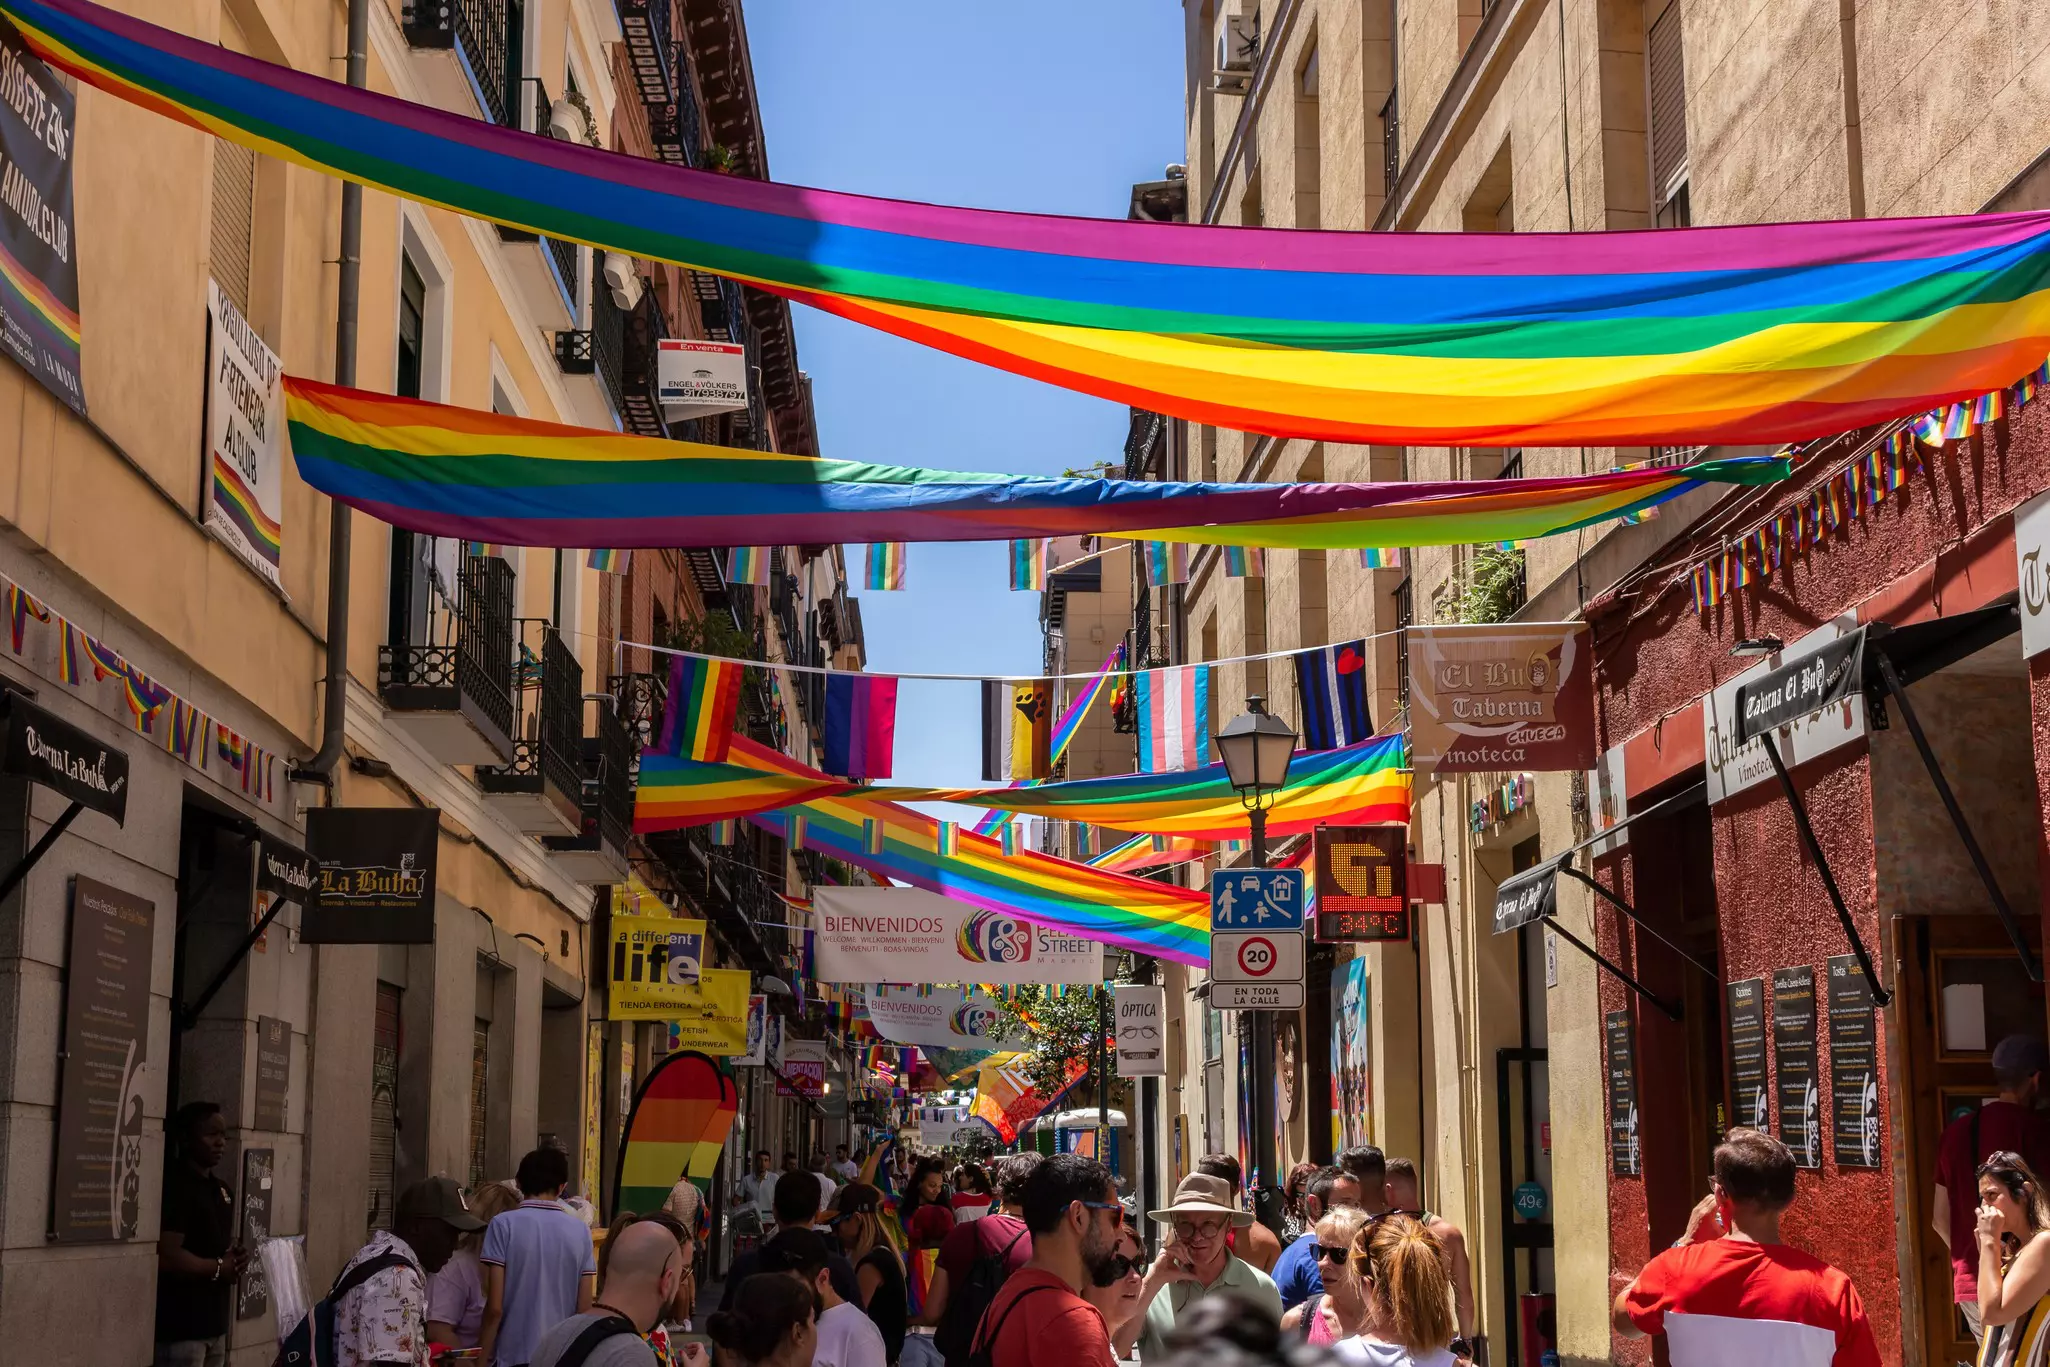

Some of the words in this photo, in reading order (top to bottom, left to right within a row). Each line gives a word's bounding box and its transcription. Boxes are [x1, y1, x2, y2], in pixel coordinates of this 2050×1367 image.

[683, 388, 744, 399] 917938797
[237, 429, 257, 487] CLUB
[1442, 662, 1473, 689] El
[1451, 696, 1543, 719] Taberna
[1746, 685, 1782, 720] Taberna
[1507, 726, 1565, 746] CHUECA
[319, 870, 350, 892] La
[825, 916, 943, 933] BIENVENIDOS
[619, 932, 627, 942] a
[631, 930, 692, 945] different
[861, 936, 907, 944] WILLKOMMEN
[1039, 934, 1094, 953] STREET
[840, 945, 879, 953] BENVENUTI
[613, 942, 700, 985] life
[1247, 951, 1268, 963] 20
[1234, 987, 1247, 995] EN
[1253, 987, 1279, 995] TODA
[619, 1001, 651, 1009] TIENDA
[871, 1000, 942, 1016] BIENVENIDOS
[1234, 996, 1246, 1005] LA
[1250, 996, 1280, 1004] CALLE
[1121, 1001, 1156, 1018] ÓPTICA
[682, 1027, 708, 1035] FETISH
[682, 1040, 729, 1049] UNDERWEAR
[1518, 1195, 1543, 1209] 49€
